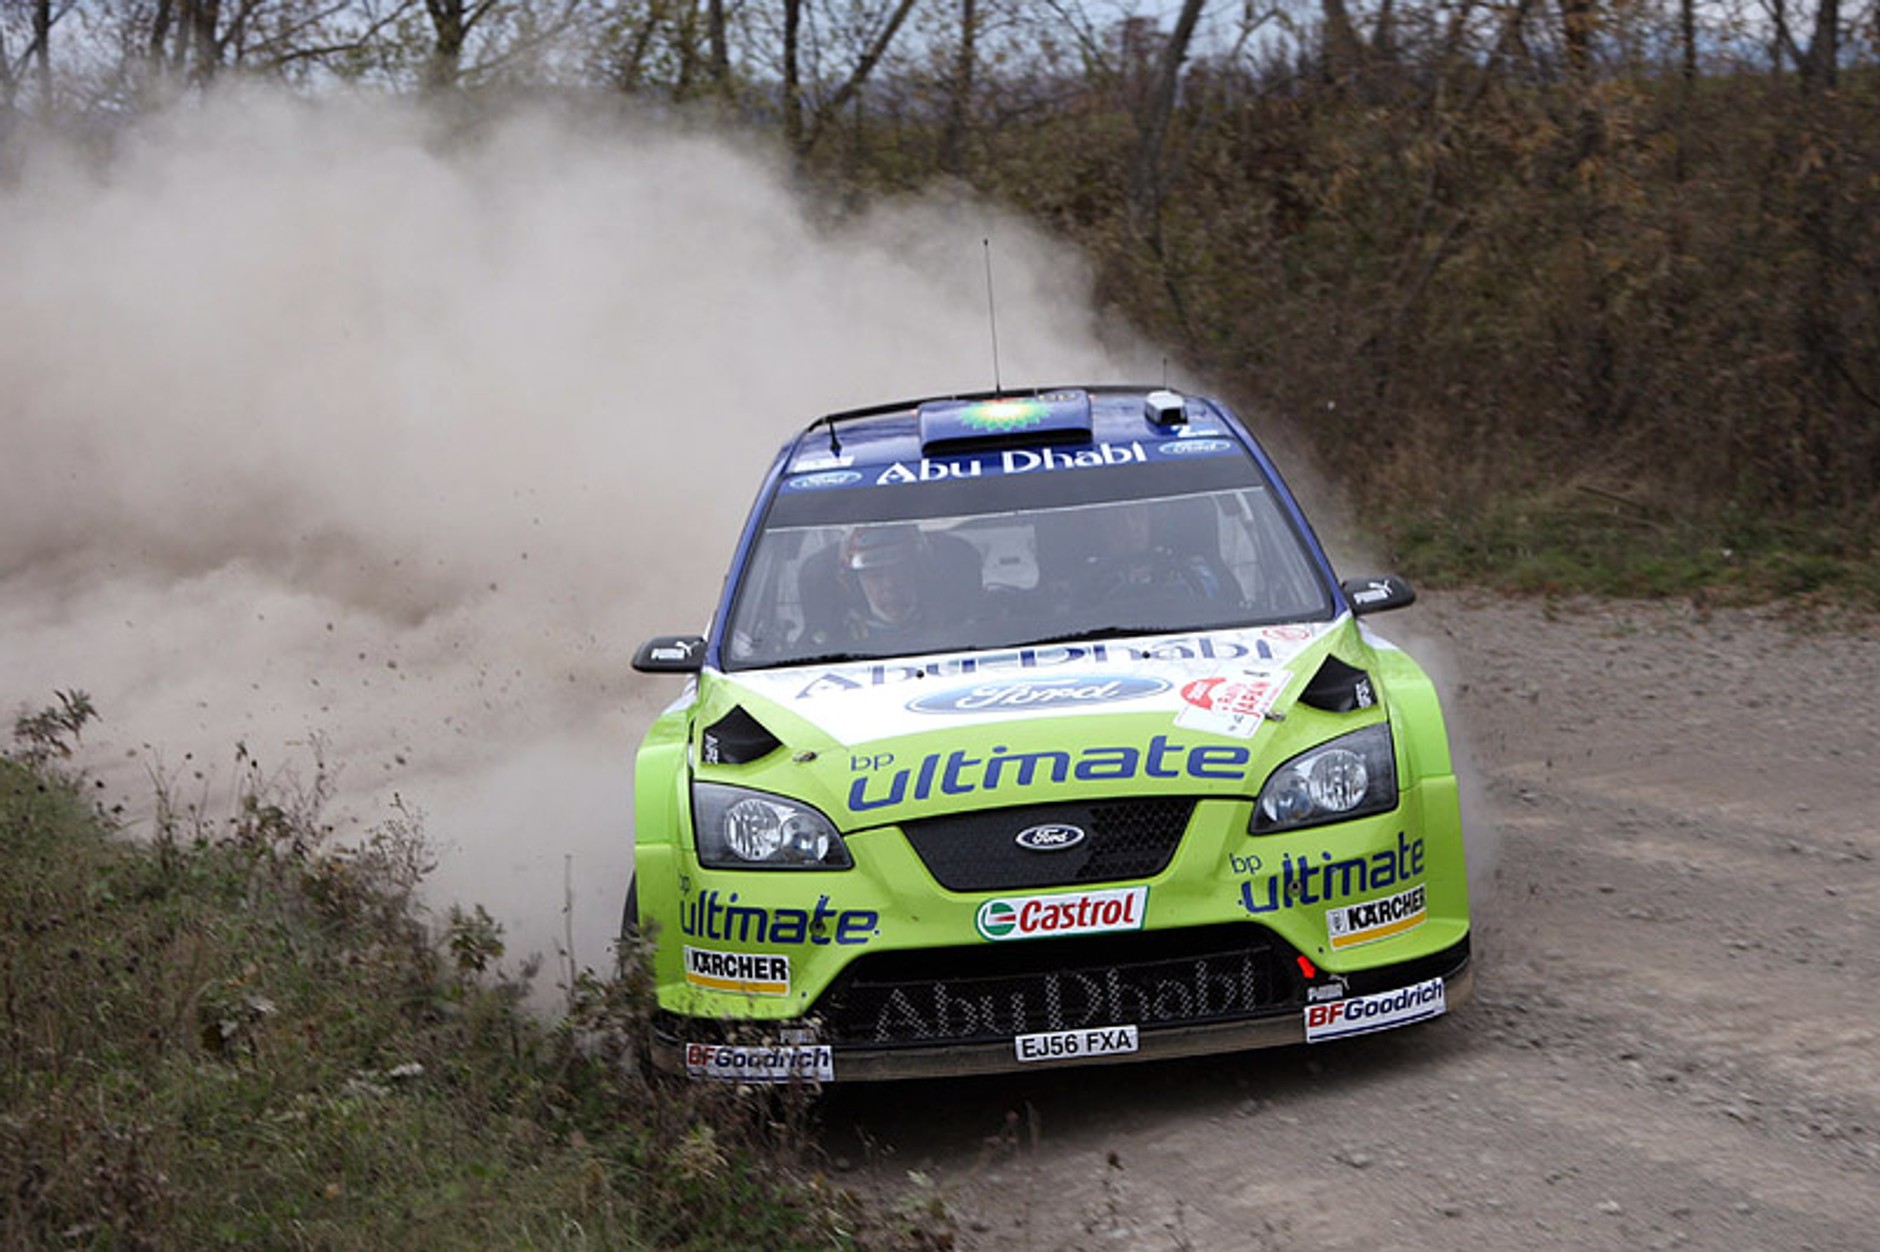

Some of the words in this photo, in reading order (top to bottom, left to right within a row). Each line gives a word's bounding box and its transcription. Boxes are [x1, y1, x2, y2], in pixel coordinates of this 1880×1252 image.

[876, 459, 982, 486] Abu
[1003, 441, 1147, 473] Dhabi
[955, 678, 1122, 709] Ford
[848, 735, 1250, 811] ultimate
[851, 751, 894, 772] bp
[1229, 853, 1262, 874] bp
[1241, 832, 1425, 913] ultimate
[680, 889, 878, 945] ultimate
[1020, 893, 1134, 932] Castrol
[875, 980, 1027, 1043] Abu
[1045, 956, 1255, 1030] Dhabi
[1309, 982, 1442, 1028] BFGoodrich
[1022, 1034, 1078, 1059] EJ56
[1086, 1030, 1133, 1054] FXA
